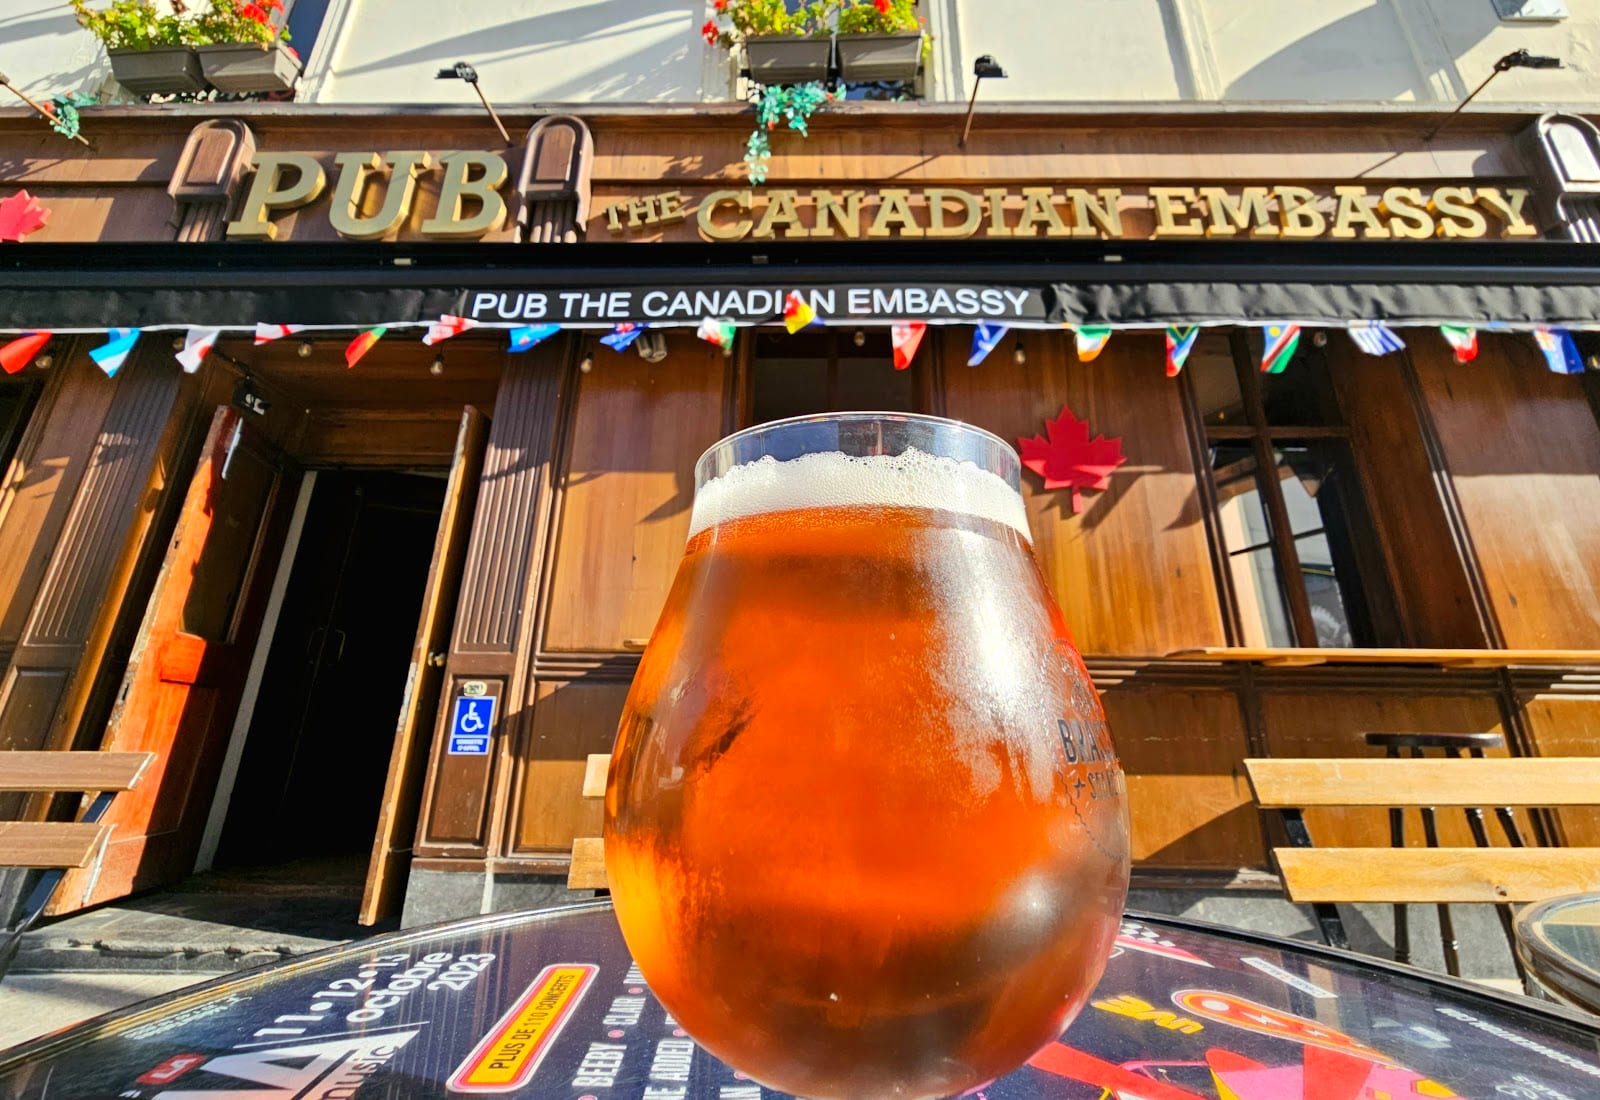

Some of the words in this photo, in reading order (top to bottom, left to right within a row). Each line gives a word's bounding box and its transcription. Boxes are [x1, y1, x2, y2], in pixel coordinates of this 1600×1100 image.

[227, 150, 508, 240] PUB
[605, 190, 686, 234] THE
[697, 187, 1124, 240] CANADIAN
[1149, 186, 1537, 239] EMBASSY
[472, 292, 548, 319] PUB
[559, 291, 632, 318] THE
[848, 288, 1029, 316] EMBASSY
[427, 953, 496, 991] 2023
[535, 974, 576, 1011] CONCERTS
[512, 1028, 536, 1040] DE
[524, 1012, 549, 1027] 110
[488, 1042, 526, 1070] PLUS
[572, 1042, 627, 1087] BEEBY
[602, 996, 647, 1026] CLAIR
[648, 1039, 695, 1081] ADDED
